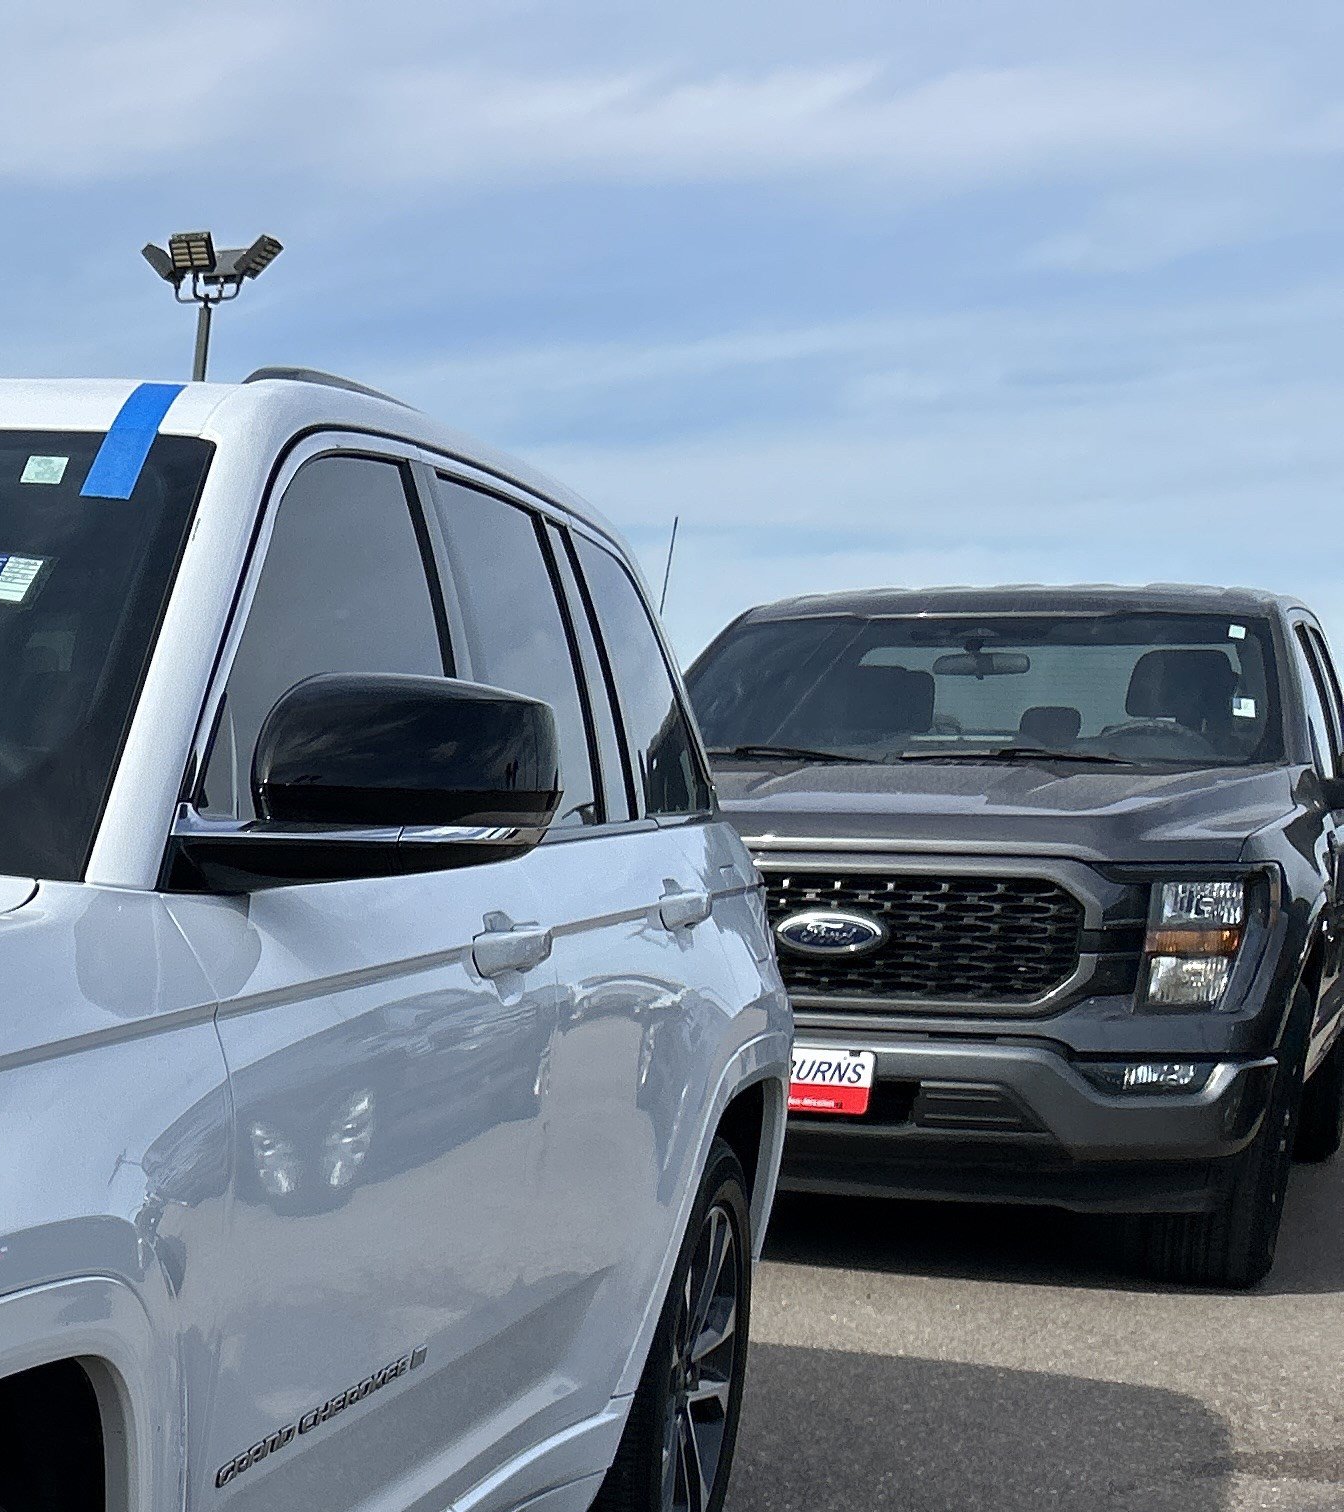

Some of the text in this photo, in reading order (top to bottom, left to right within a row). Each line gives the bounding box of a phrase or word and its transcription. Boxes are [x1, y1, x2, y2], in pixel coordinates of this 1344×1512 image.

[799, 920, 858, 943] Ford
[215, 1352, 412, 1489] GRAND CHEROKEE
